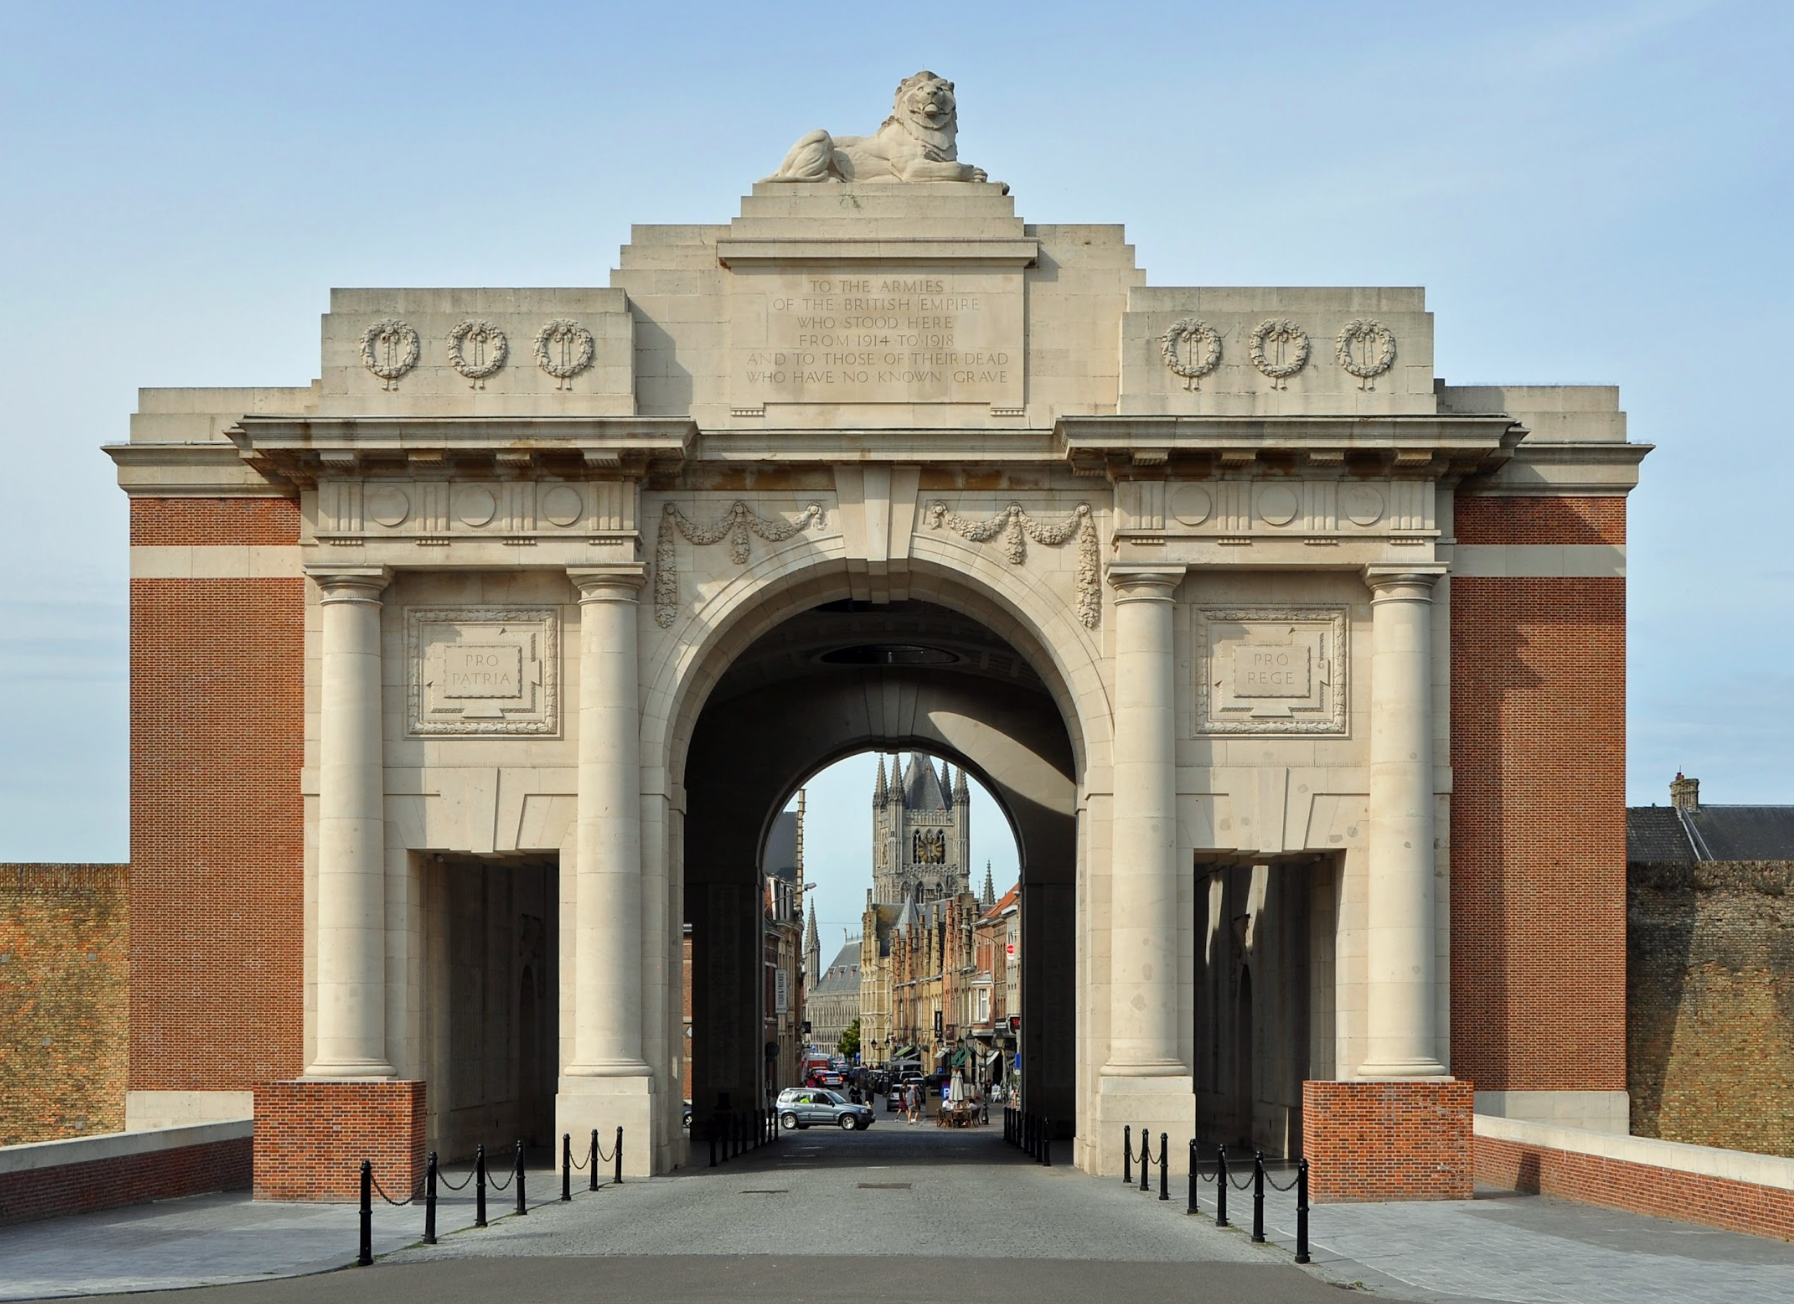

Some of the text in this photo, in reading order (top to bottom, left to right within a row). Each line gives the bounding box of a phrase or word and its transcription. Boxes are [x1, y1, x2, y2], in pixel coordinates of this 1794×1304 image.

[810, 280, 944, 293] TO THE ARMIES
[773, 298, 980, 311] OF THE BRITISH EMPIRE
[797, 317, 953, 329] WHO STOOD HERE
[800, 334, 954, 347] FROM 1914 TO 1918
[747, 353, 1008, 366] AND TO THOSE OF THEIR DEAD
[747, 371, 1008, 384] WHO HAVE NO KNOWN GRAVE
[465, 655, 498, 667] PRO
[1254, 653, 1289, 666] PRO
[453, 673, 511, 685] PATRIA
[1247, 672, 1295, 685] REGE
